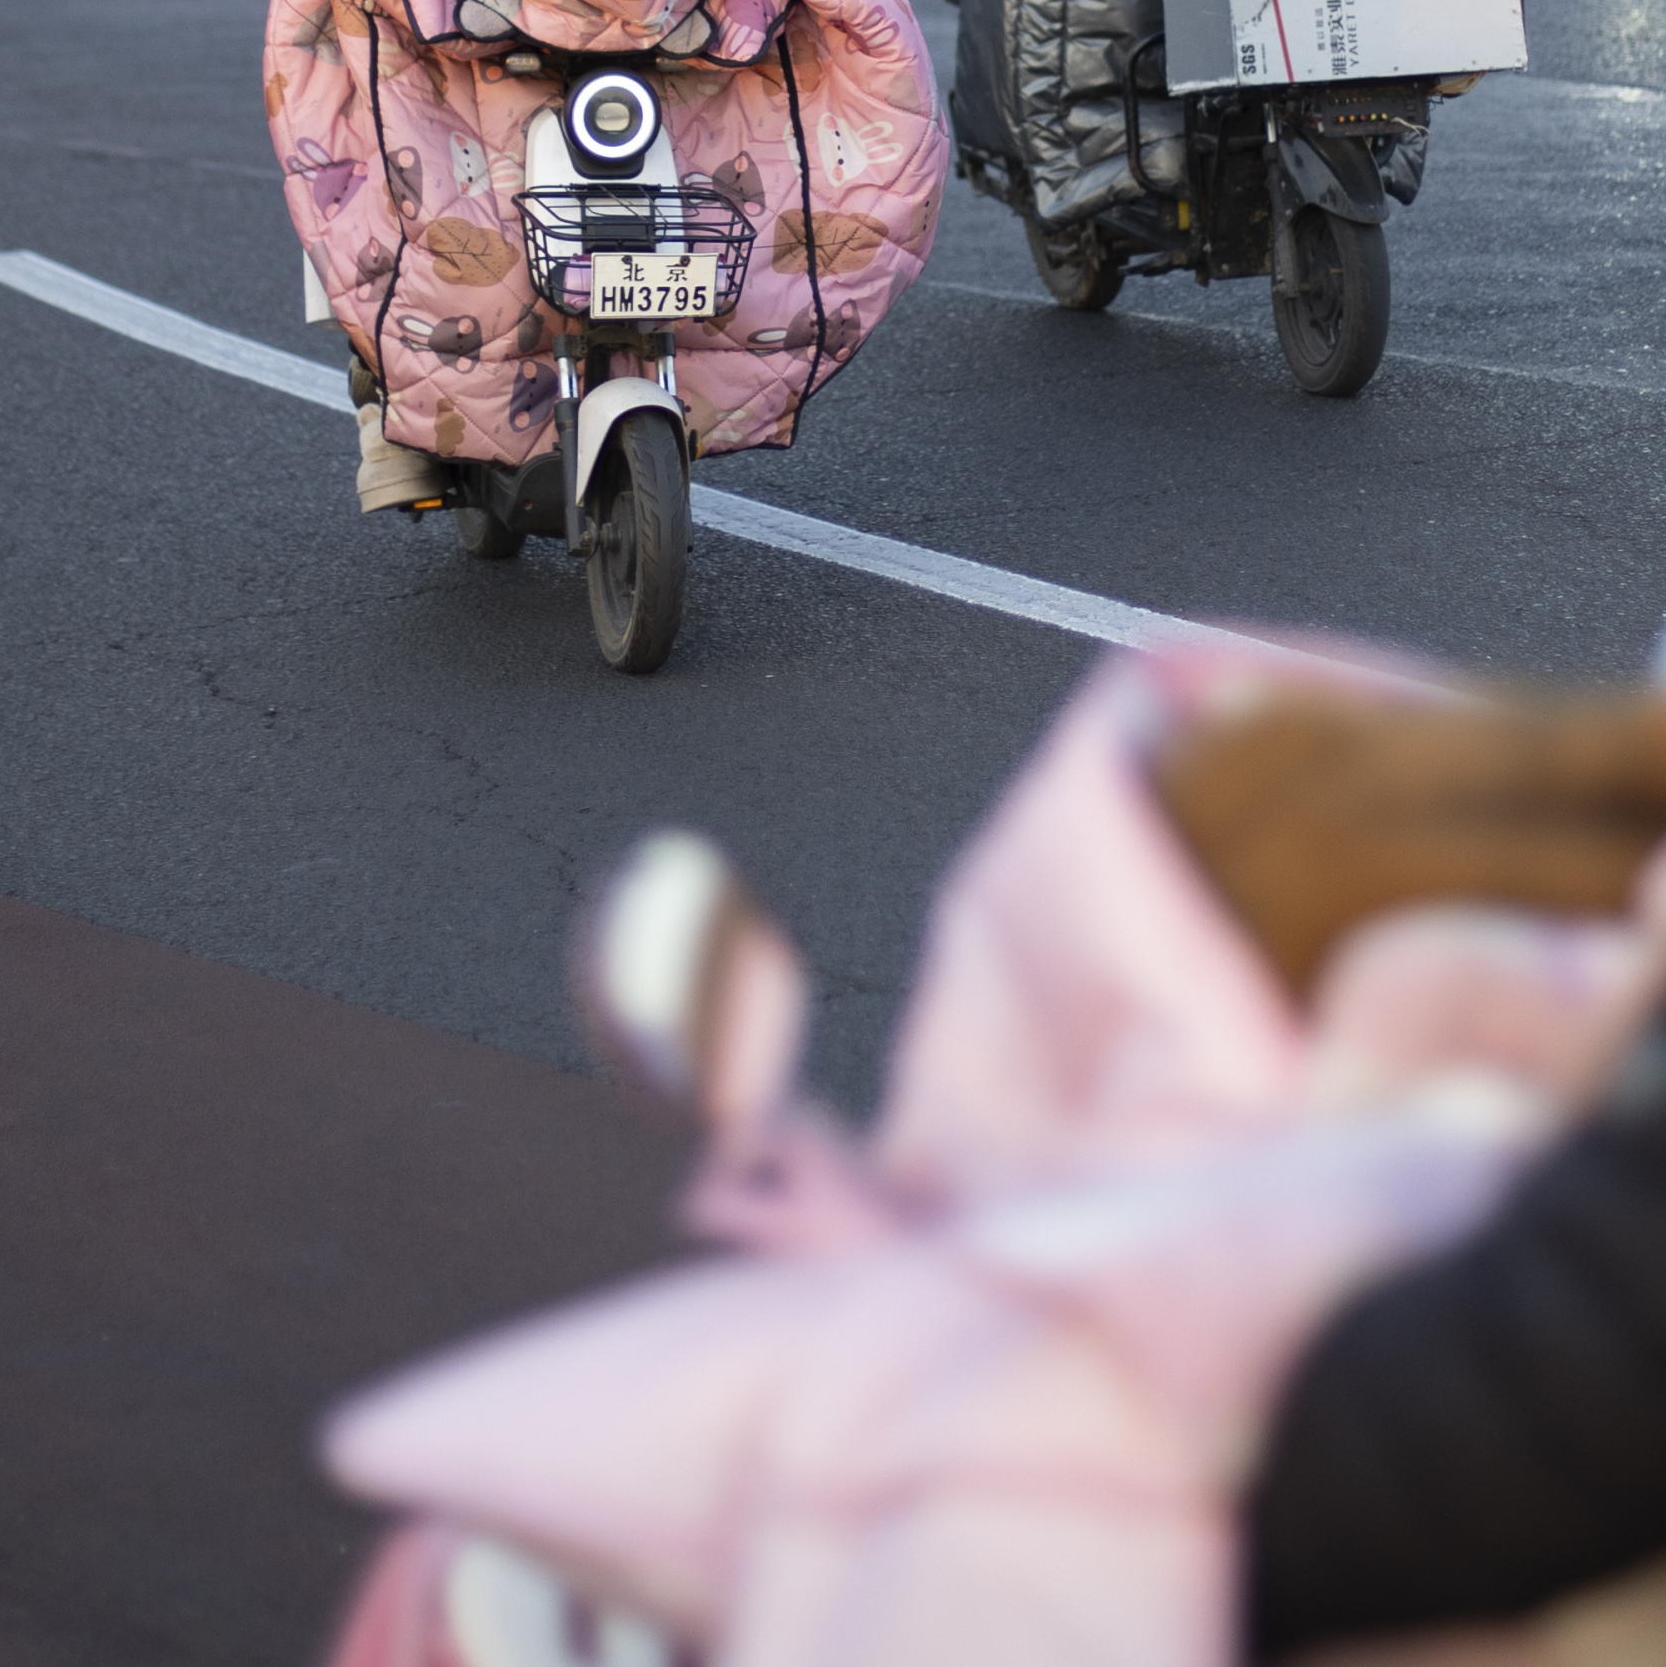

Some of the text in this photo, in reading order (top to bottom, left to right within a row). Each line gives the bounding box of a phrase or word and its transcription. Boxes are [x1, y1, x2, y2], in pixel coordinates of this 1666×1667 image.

[1345, 14, 1360, 68] YARET
[1241, 44, 1257, 75] SGS
[622, 262, 689, 283] 北京
[601, 285, 707, 312] HM3795
